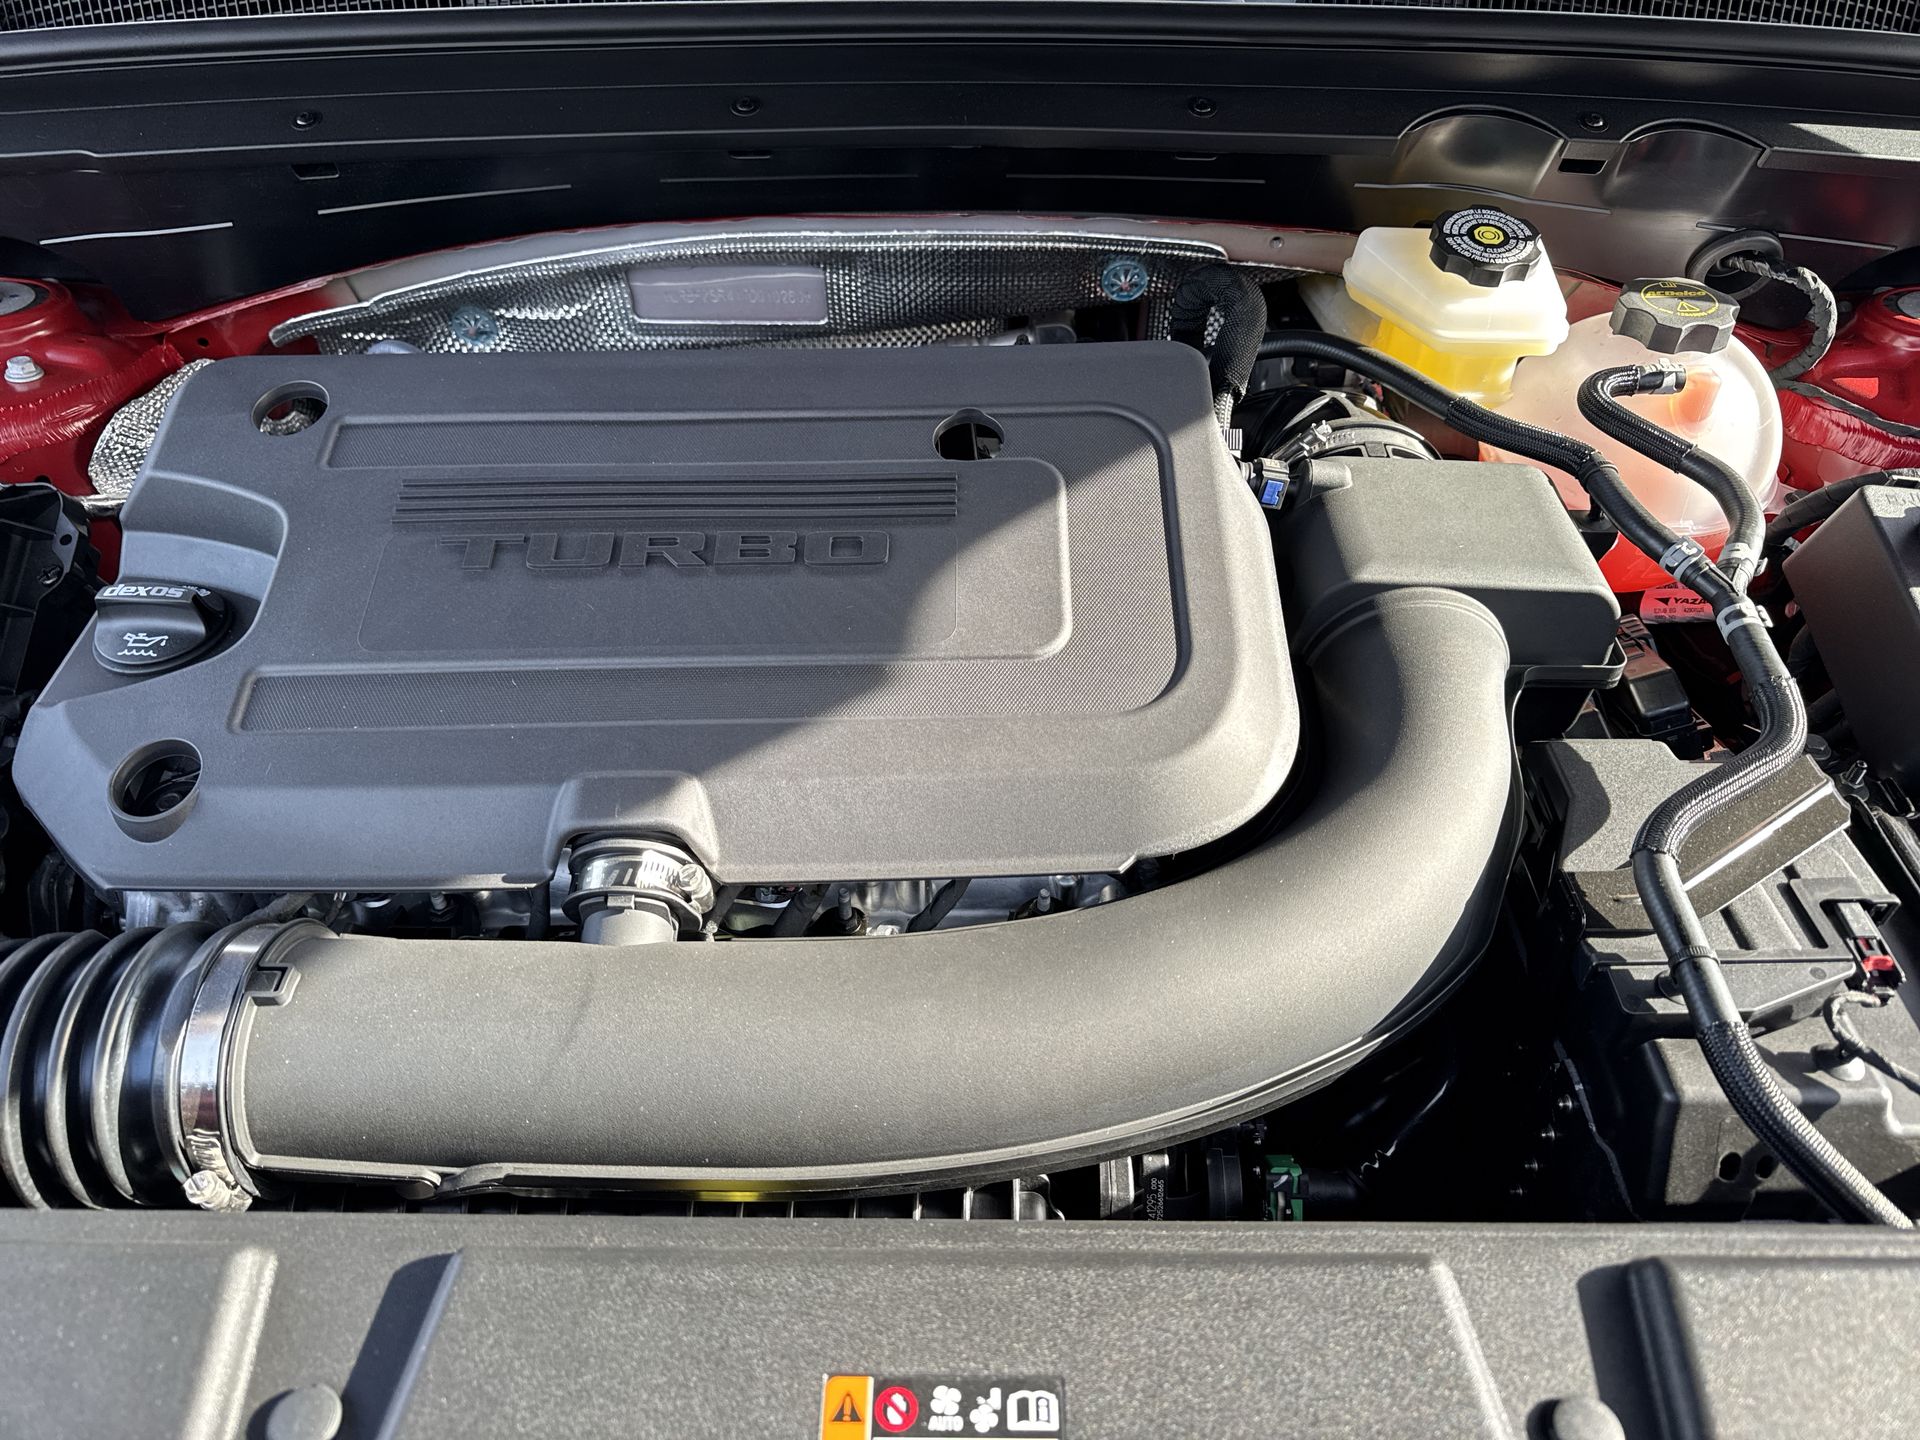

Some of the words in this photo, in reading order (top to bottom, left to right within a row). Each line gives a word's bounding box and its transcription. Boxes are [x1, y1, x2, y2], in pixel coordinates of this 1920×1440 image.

[1470, 254, 1489, 263] FROM
[440, 530, 890, 570] TURBO
[103, 584, 185, 598] dexos
[927, 1415, 964, 1432] AUTO
